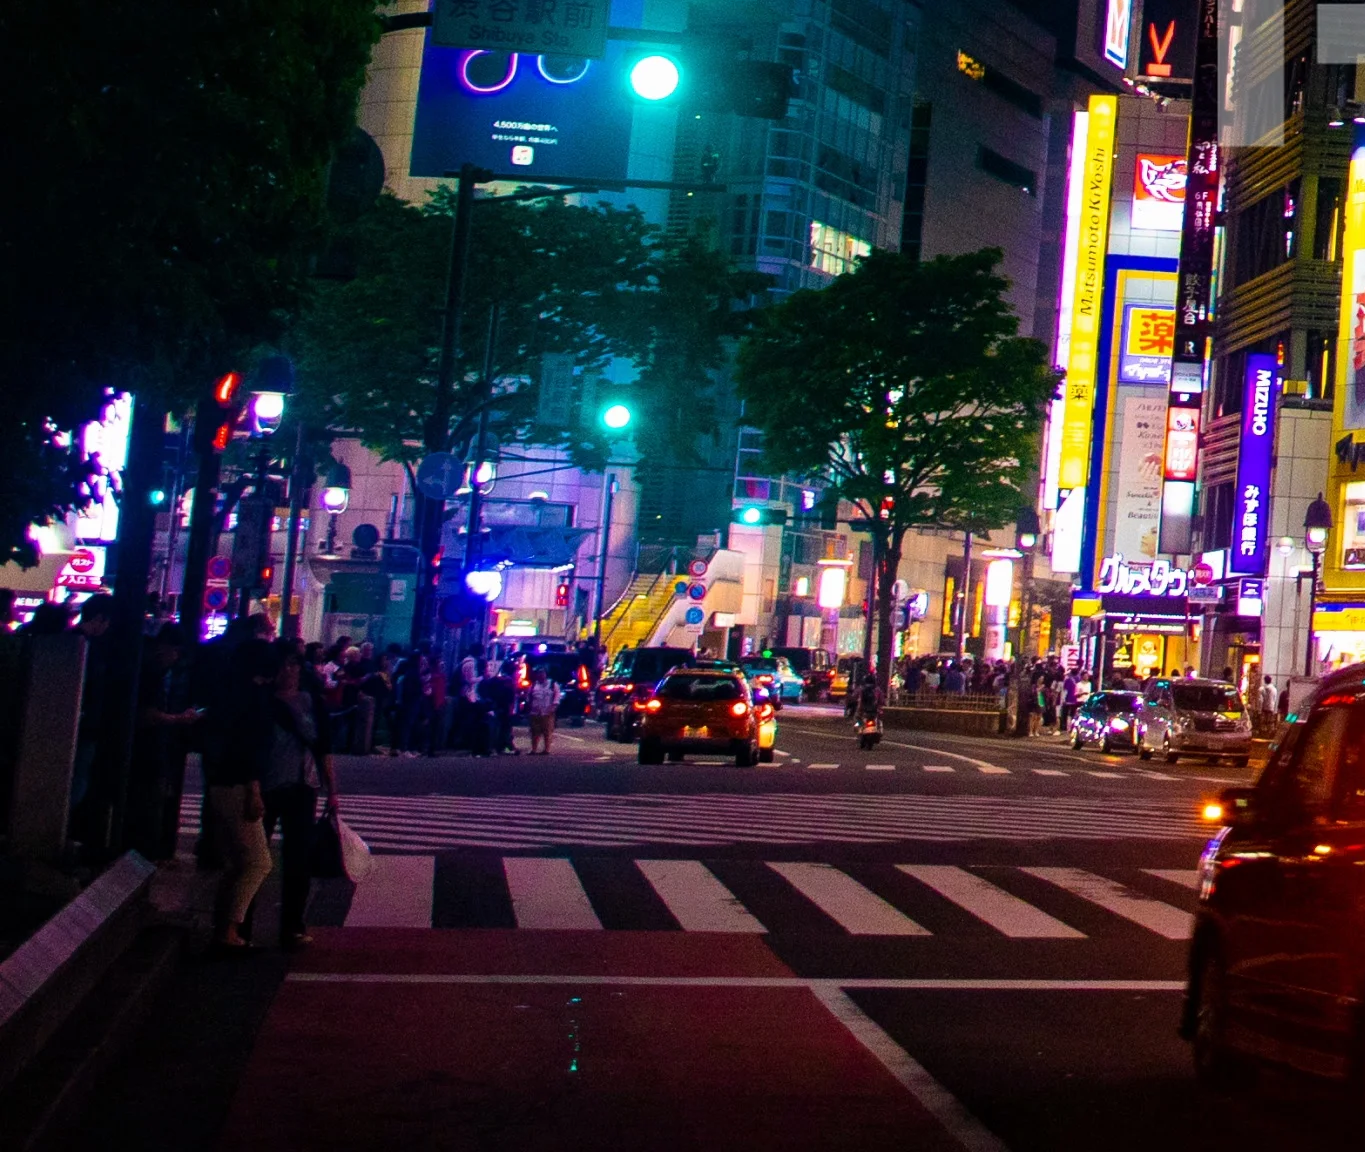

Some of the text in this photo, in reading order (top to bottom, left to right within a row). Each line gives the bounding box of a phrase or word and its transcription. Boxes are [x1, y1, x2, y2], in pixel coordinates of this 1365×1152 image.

[468, 24, 536, 46] Shibuya
[1252, 369, 1272, 436] MIZUHO
[68, 576, 87, 585] 入口
